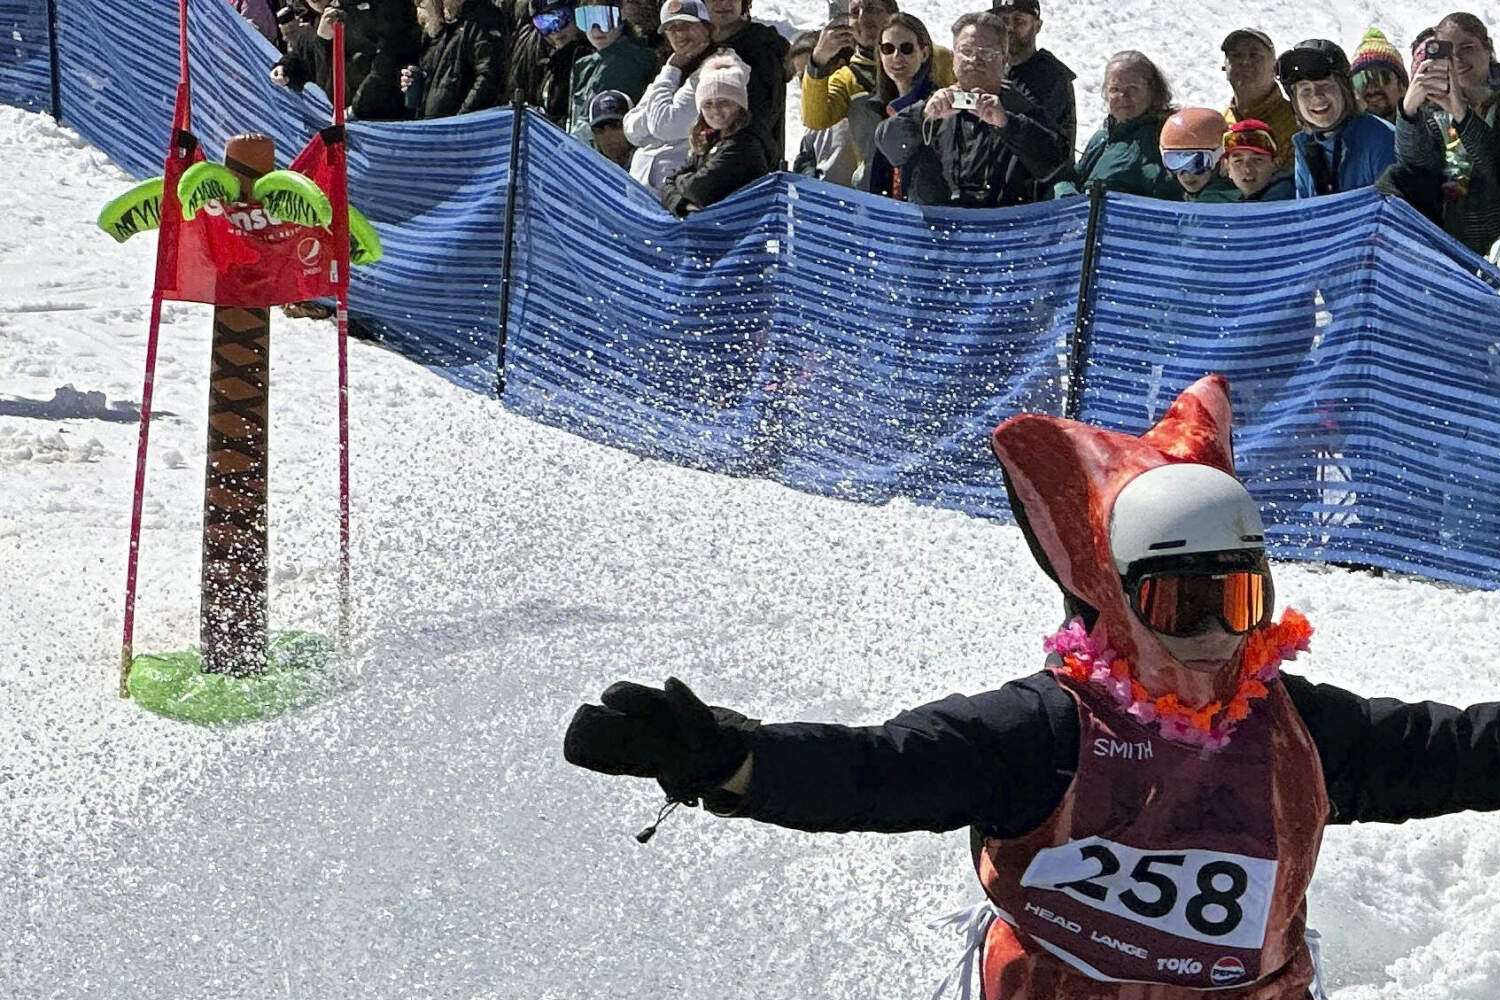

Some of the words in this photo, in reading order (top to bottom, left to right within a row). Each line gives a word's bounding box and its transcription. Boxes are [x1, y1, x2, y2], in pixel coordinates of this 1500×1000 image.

[1093, 738, 1154, 760] SMITH
[1054, 845, 1248, 936] 258
[1024, 902, 1082, 934] HEAD
[1090, 931, 1149, 959] LANGE
[1157, 957, 1203, 975] TOKO
